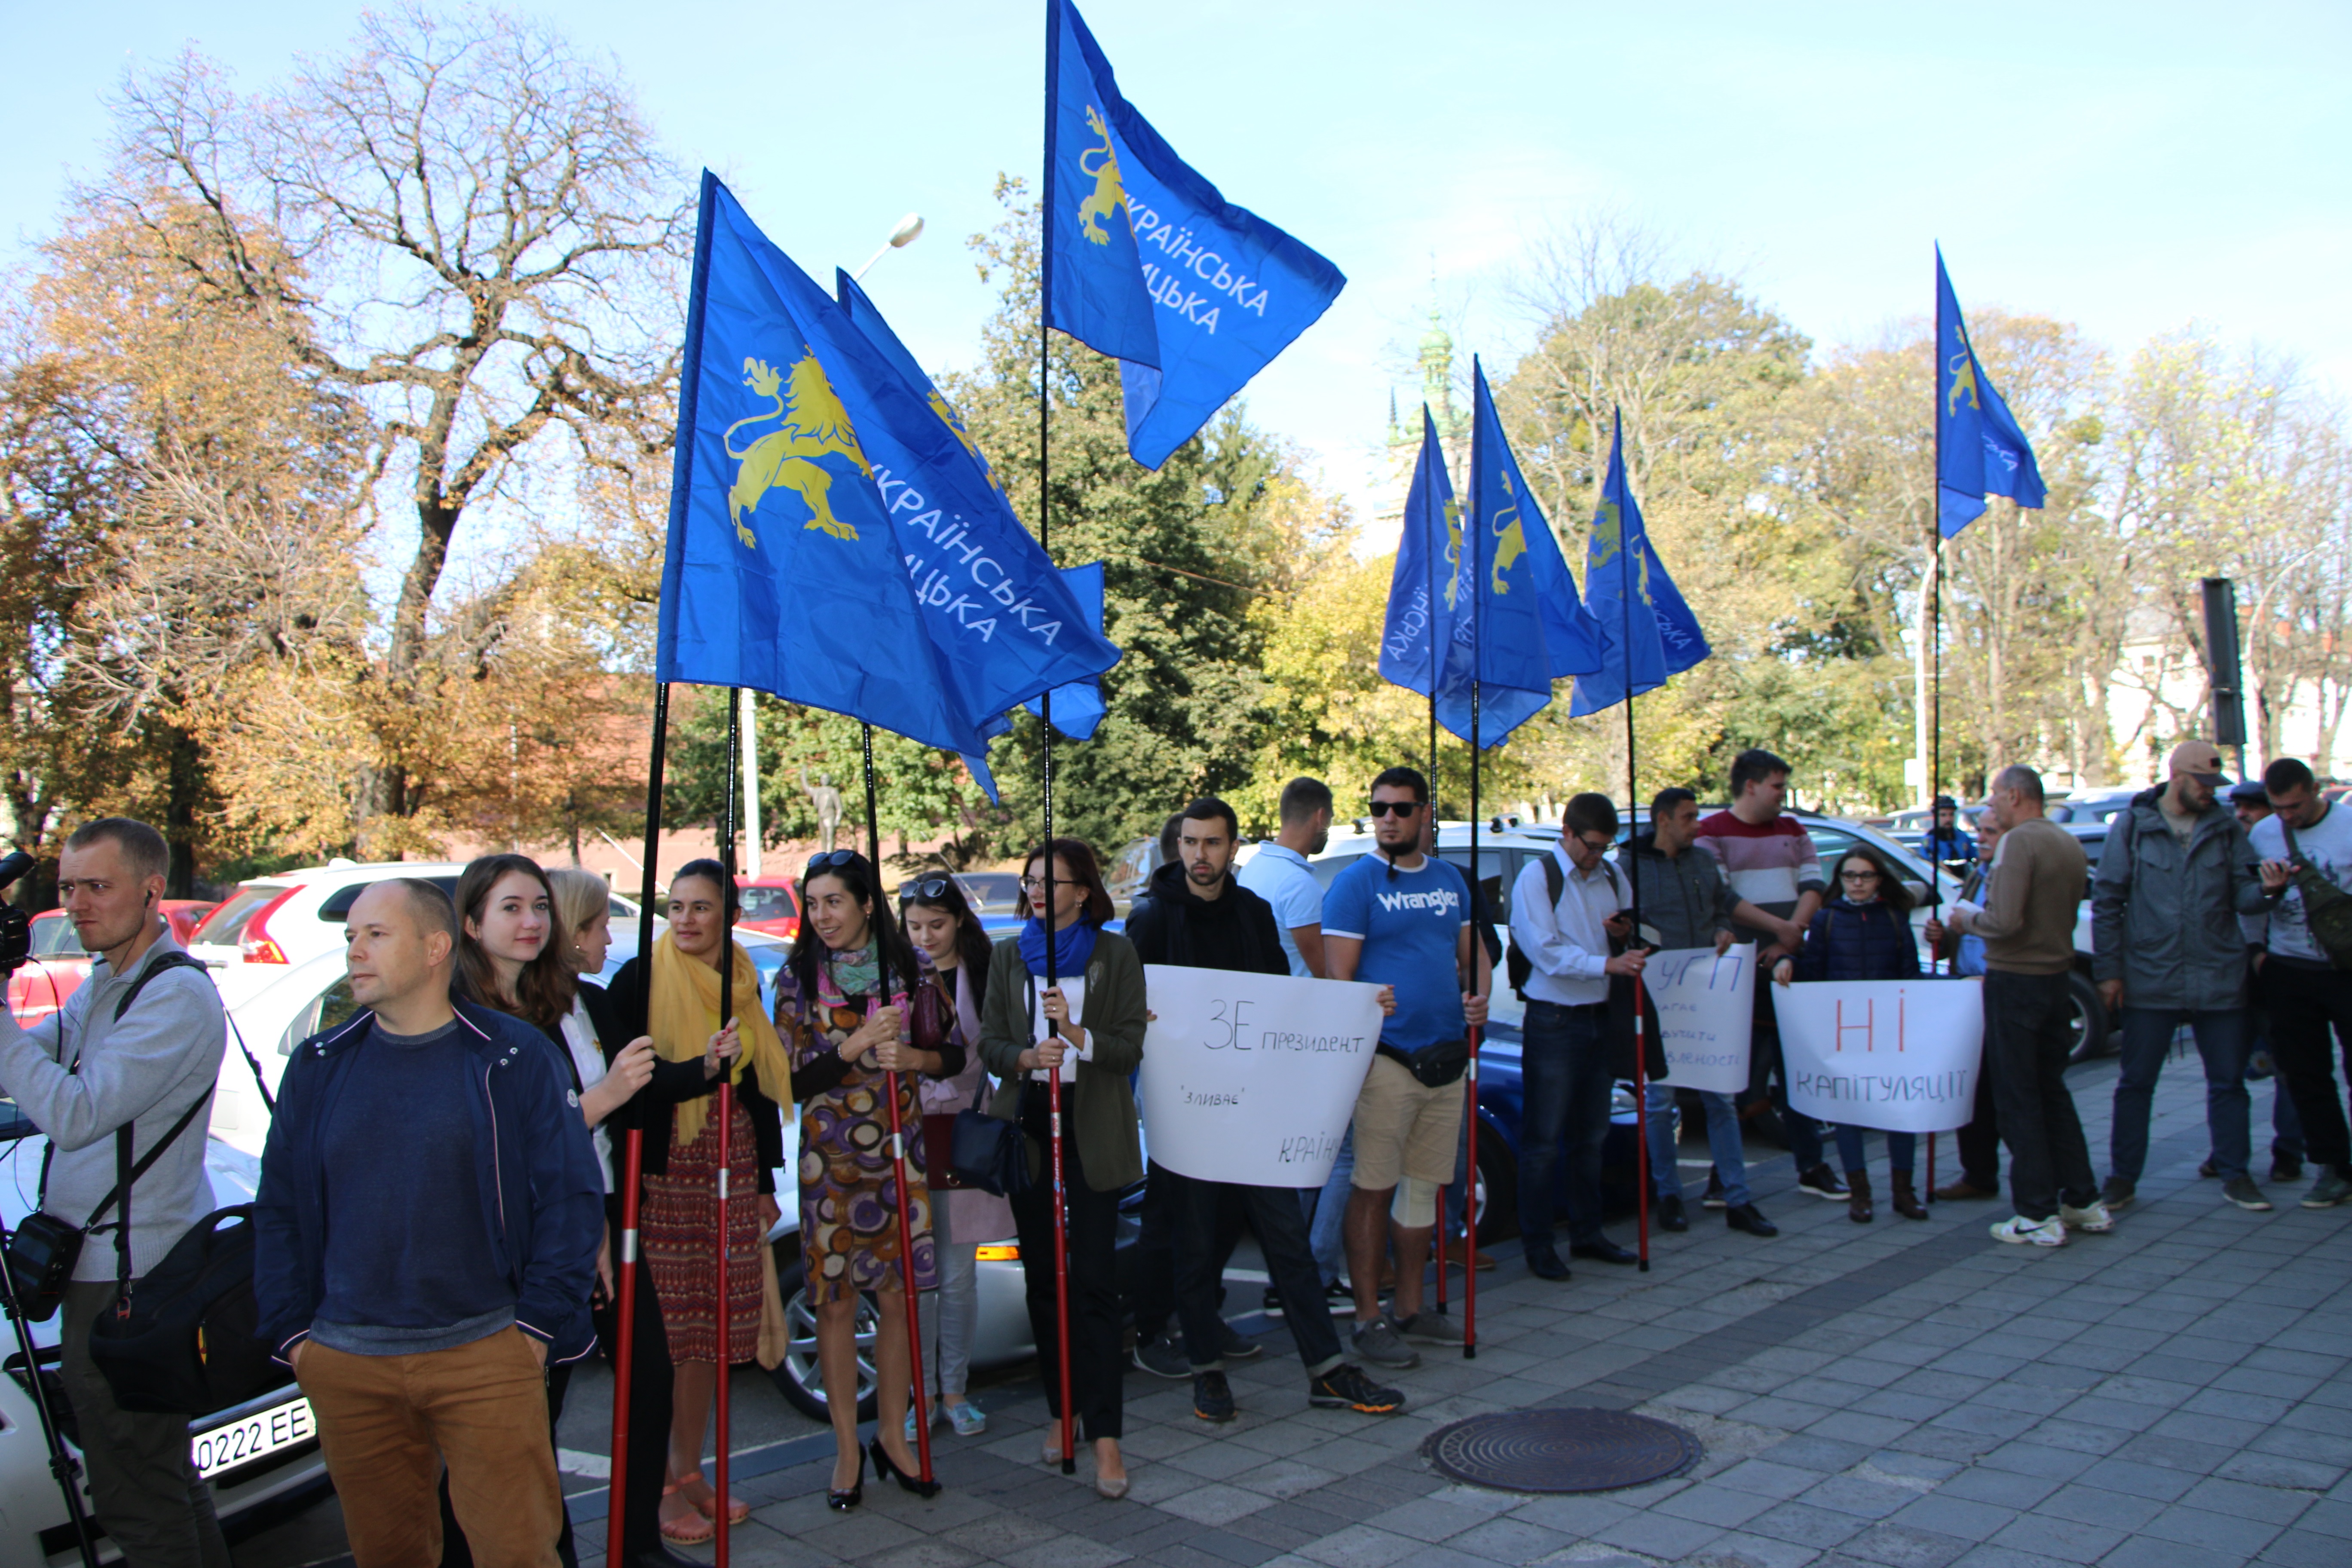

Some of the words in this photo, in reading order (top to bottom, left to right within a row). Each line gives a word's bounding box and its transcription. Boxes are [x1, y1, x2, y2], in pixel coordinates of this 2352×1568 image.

[1125, 193, 1268, 316] КРАЇНСЬКА
[871, 464, 1062, 645] КРАЇНСЬКА
[904, 554, 997, 642] ЦЬКА
[1376, 888, 1459, 916] Wrangler
[1658, 955, 1743, 992] УГП
[1204, 999, 1255, 1050] ЗЕ
[1836, 988, 1905, 1052] НІ
[1666, 1051, 1740, 1066] ВЛЕНОСТІ
[198, 1422, 262, 1471] 0222
[271, 1404, 308, 1446] EE
